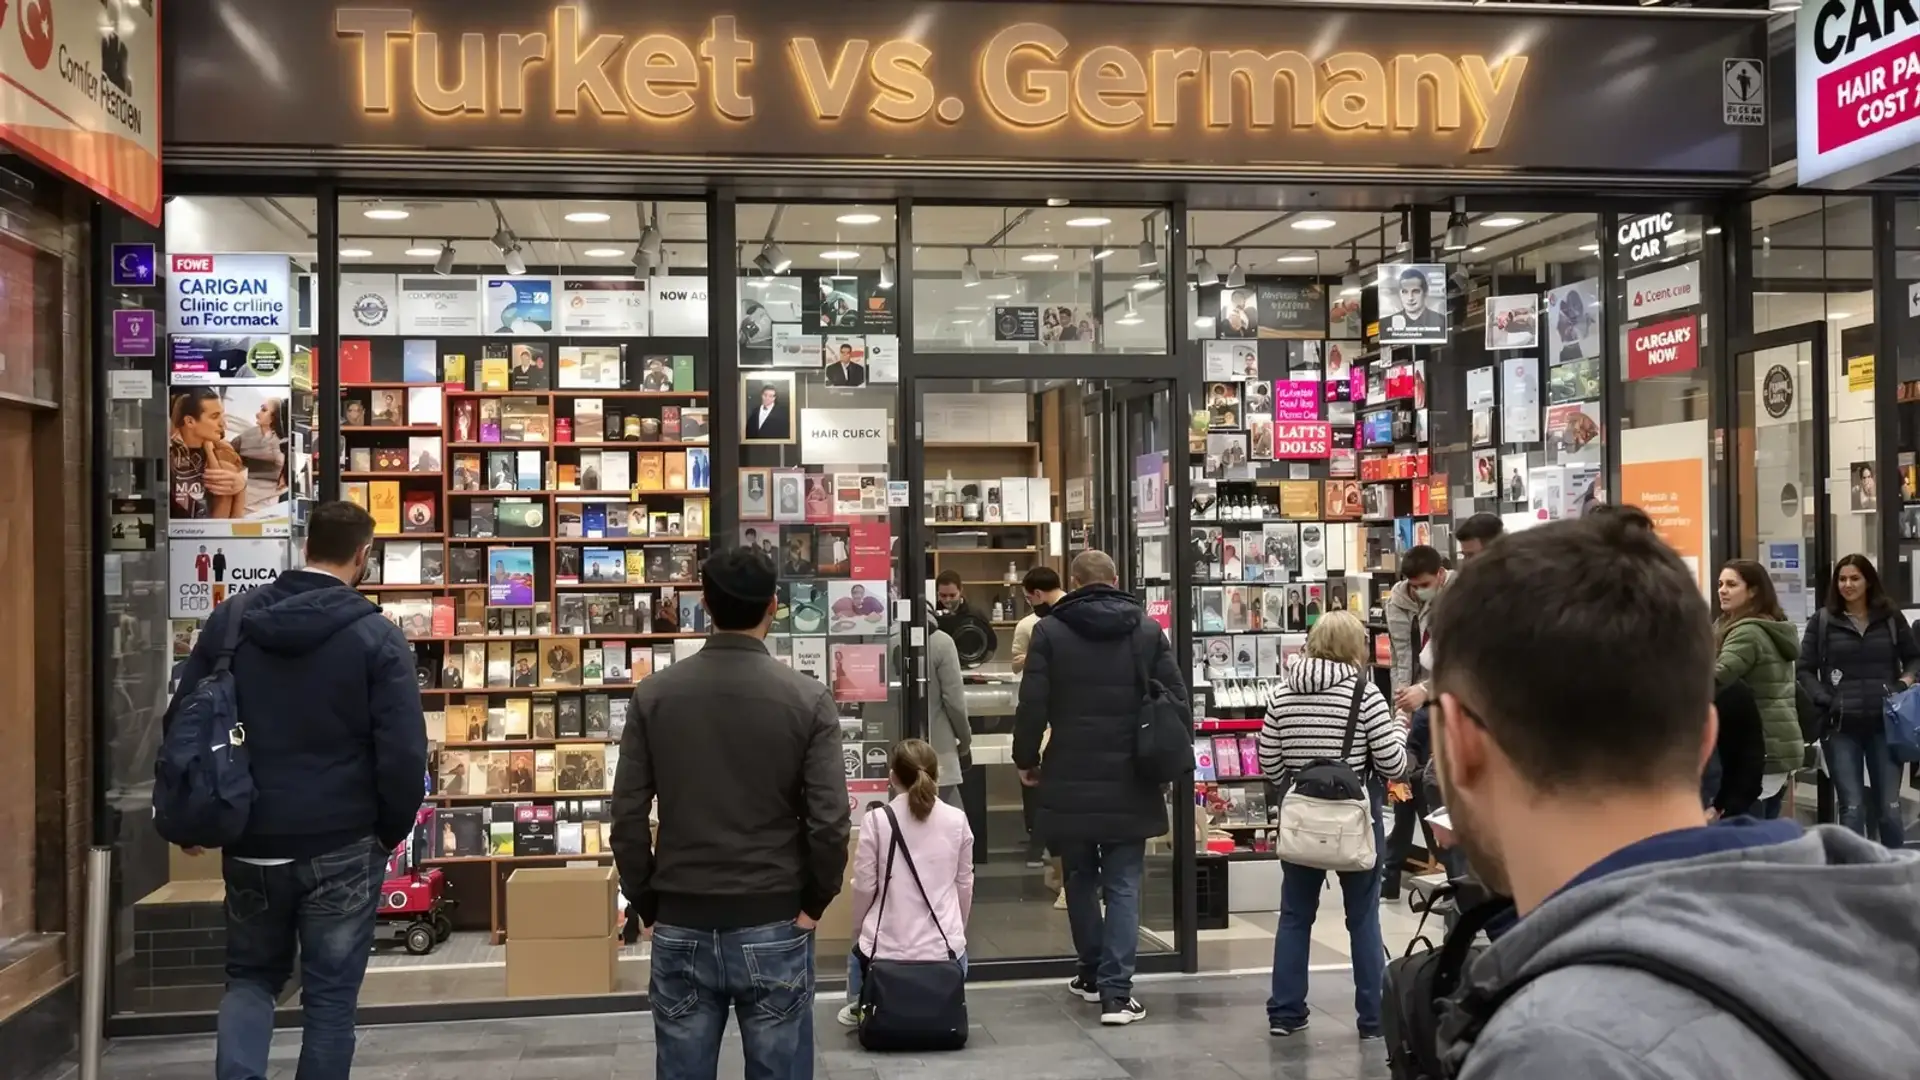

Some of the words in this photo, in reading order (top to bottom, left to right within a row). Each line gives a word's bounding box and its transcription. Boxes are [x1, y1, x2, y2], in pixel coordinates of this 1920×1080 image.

[336, 5, 754, 120] Turket
[790, 36, 966, 124] vs.
[980, 21, 1529, 153] Germany
[1837, 66, 1887, 108] HAIR
[1857, 87, 1909, 128] COST
[1630, 238, 1661, 261] CAR
[180, 278, 267, 295] CARIGAN
[660, 291, 688, 300] NOW
[181, 315, 199, 326] un
[811, 429, 839, 438] HAIR
[179, 583, 209, 595] COR
